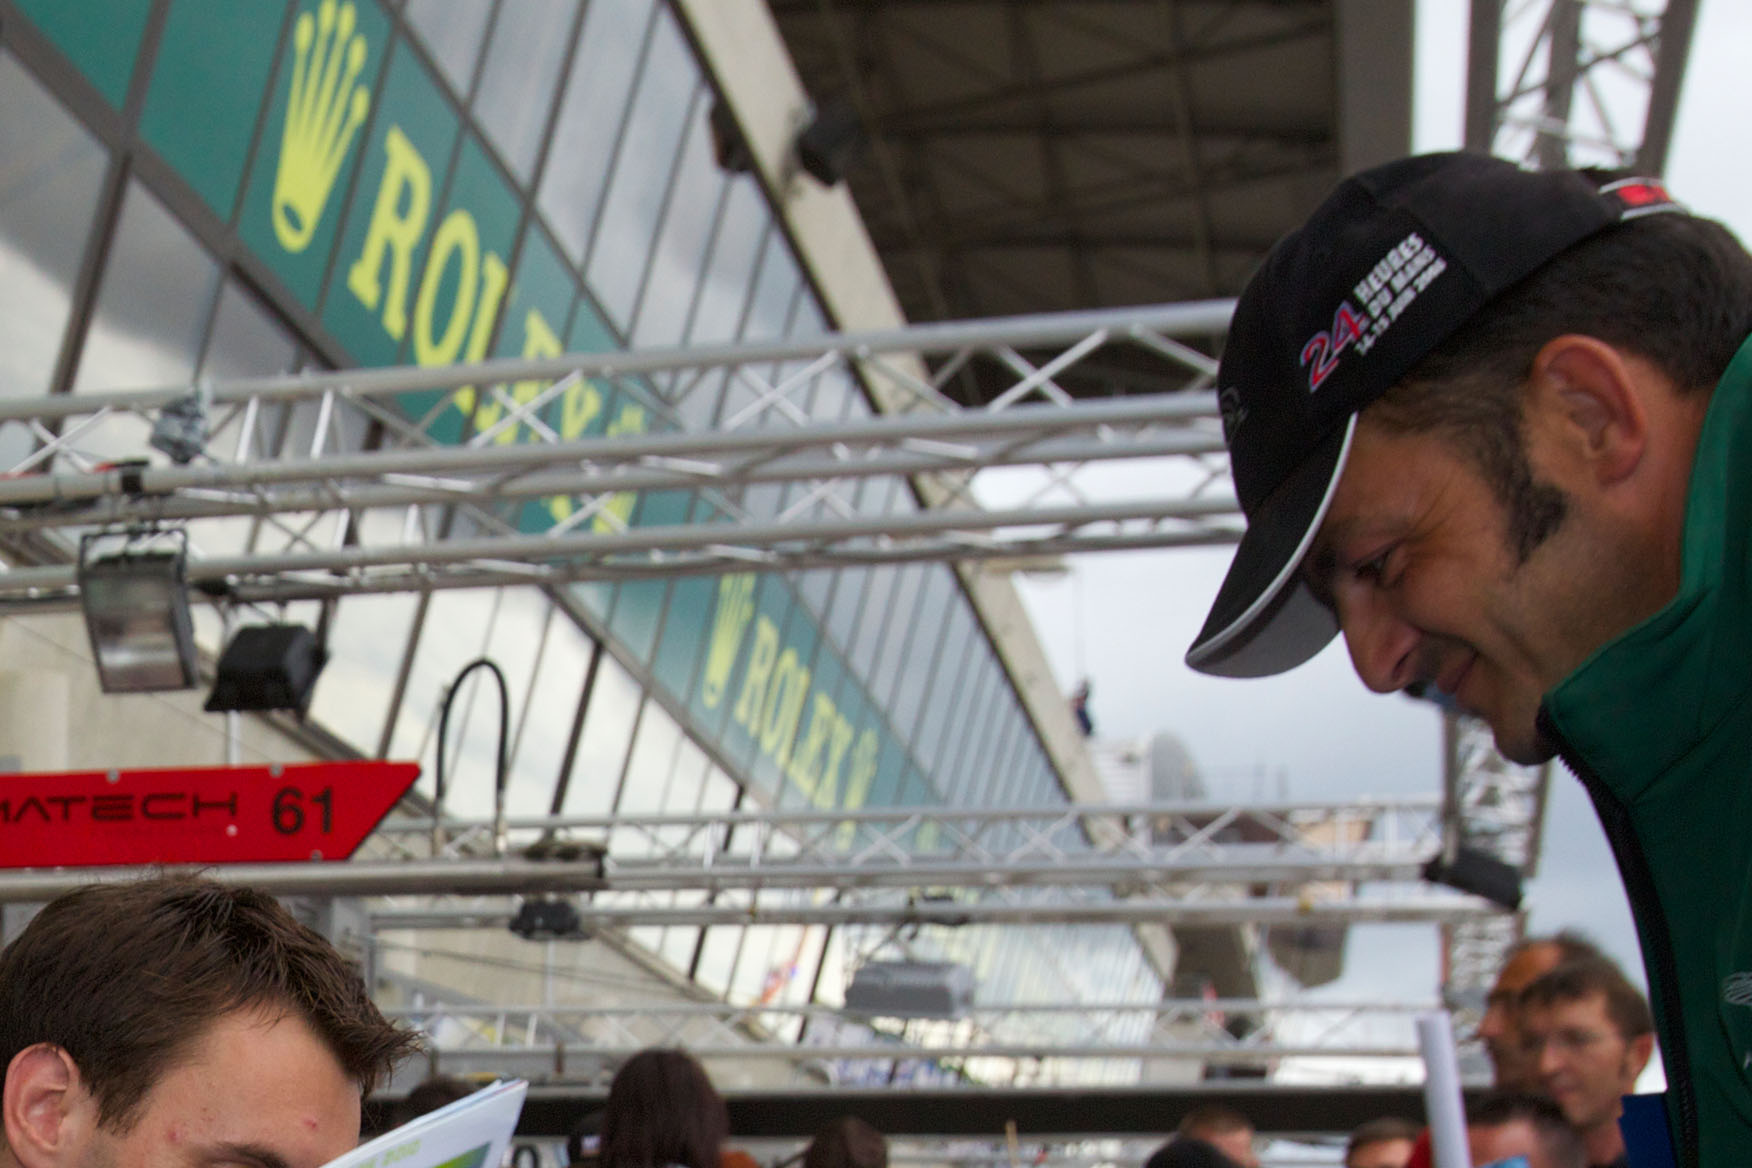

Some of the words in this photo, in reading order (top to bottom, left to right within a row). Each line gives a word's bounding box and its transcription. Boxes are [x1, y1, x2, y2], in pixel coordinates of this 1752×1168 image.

[1353, 231, 1424, 305] HEURES
[1368, 286, 1393, 320] DU
[1390, 244, 1436, 293] MANS
[1300, 301, 1371, 393] 24
[734, 612, 855, 811] ROLEX
[271, 786, 334, 835] 61
